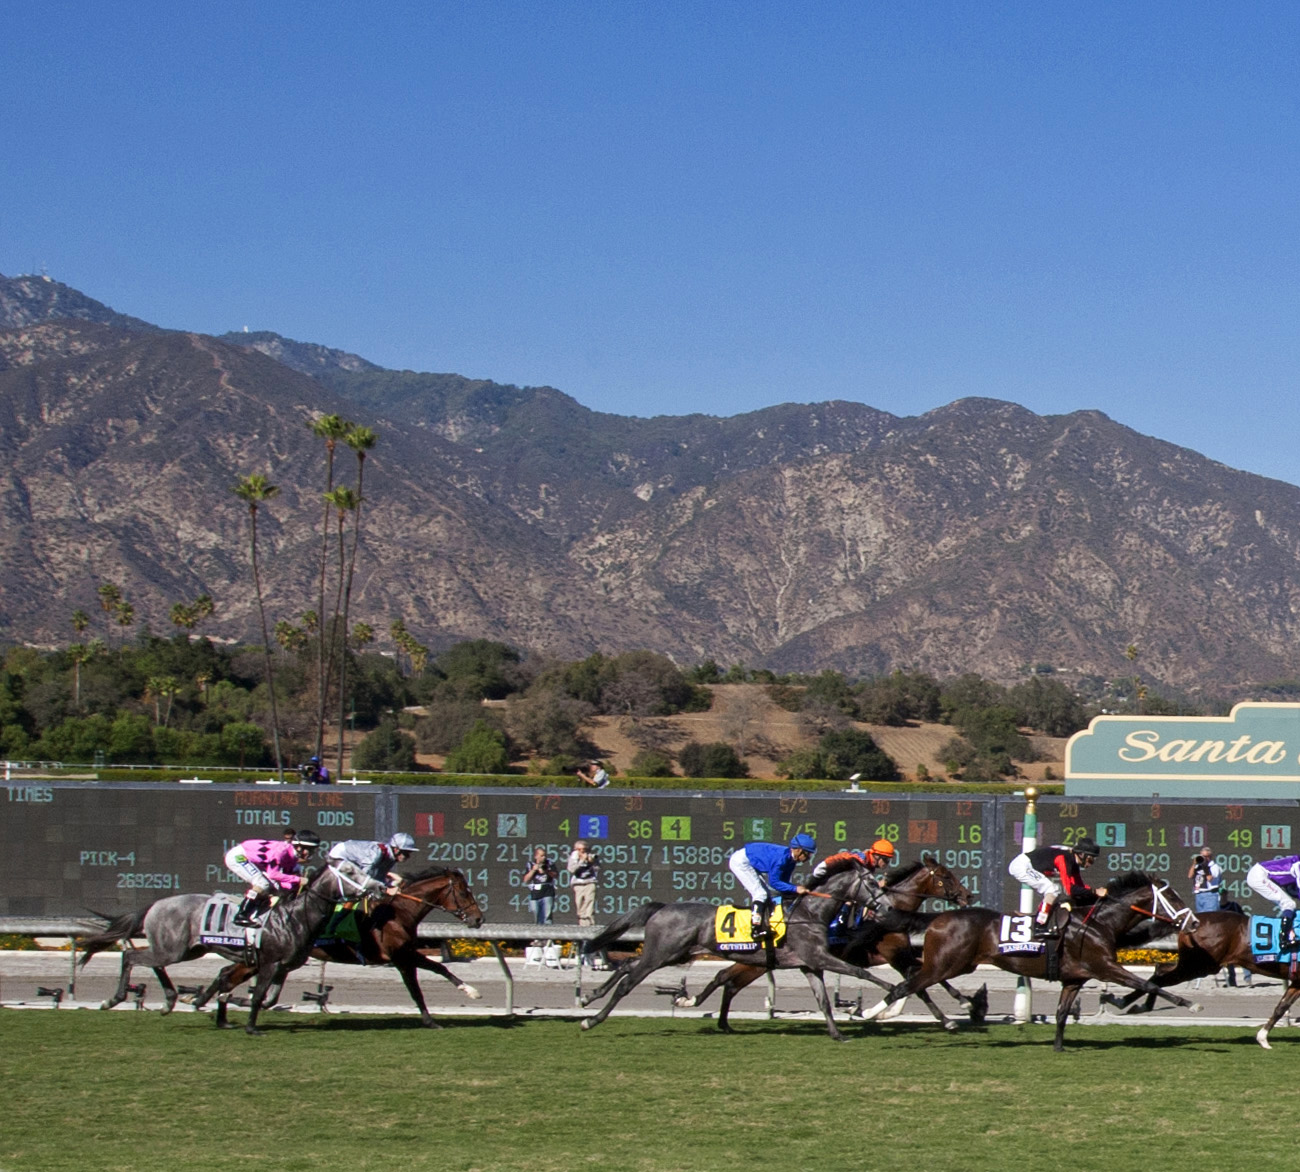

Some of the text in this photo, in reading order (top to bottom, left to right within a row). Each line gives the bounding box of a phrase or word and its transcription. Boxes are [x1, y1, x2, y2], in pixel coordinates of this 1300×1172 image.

[1118, 729, 1286, 765] Santa
[6, 787, 54, 803] TIMES
[234, 791, 344, 807] MORNING LINE
[234, 809, 355, 827] TOTALS ODDS
[427, 814, 435, 836] 1
[463, 817, 489, 837] 48
[506, 815, 518, 837] 2
[558, 818, 571, 838] 4
[587, 816, 601, 839] 3
[627, 820, 653, 839] 36
[670, 818, 682, 839] 4
[722, 821, 736, 841] 5
[751, 819, 765, 841] 5
[834, 820, 847, 842] 6
[874, 823, 900, 843] 48
[957, 824, 982, 844] 16
[1105, 824, 1117, 847] 9
[1145, 828, 1168, 847] 11
[1183, 825, 1204, 848] 10
[1227, 828, 1253, 848] 49
[1265, 827, 1286, 848] 11
[79, 851, 136, 867] PICK-4
[427, 842, 490, 862] 22067
[661, 845, 735, 866] 158864
[1107, 853, 1171, 873] 85929
[116, 873, 182, 889] 2692591
[596, 870, 653, 890] 3374
[672, 871, 736, 891] 58749
[204, 904, 229, 932] 11
[720, 911, 737, 939] 4
[1000, 915, 1033, 942] 13
[1255, 922, 1273, 951] 9
